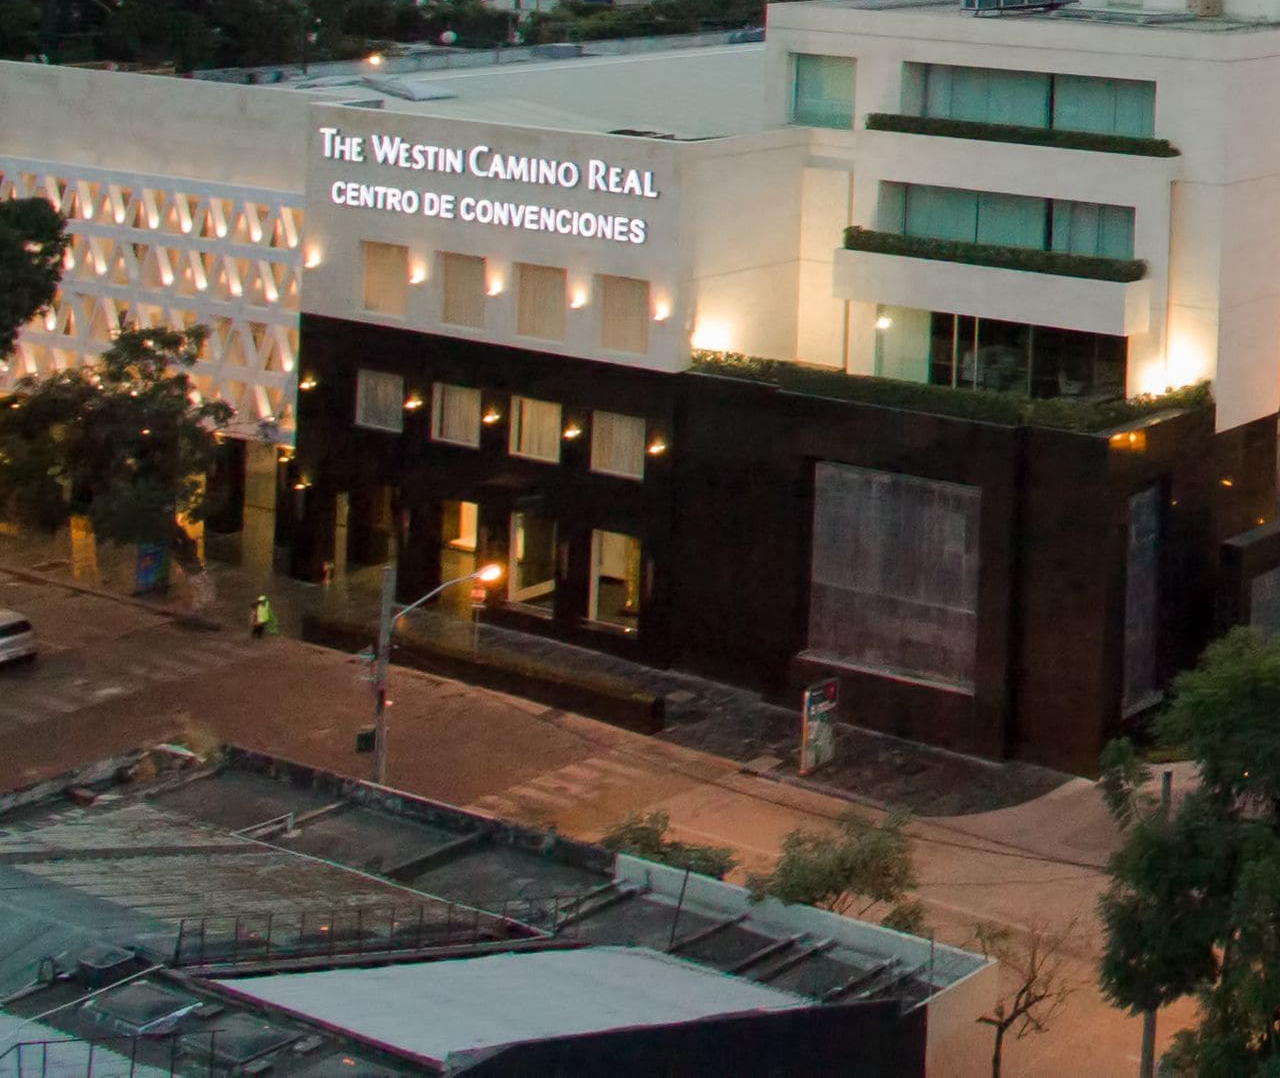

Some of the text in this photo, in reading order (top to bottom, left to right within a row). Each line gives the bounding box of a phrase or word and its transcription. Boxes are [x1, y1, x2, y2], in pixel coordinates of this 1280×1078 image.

[319, 127, 660, 199] THE WESTIN CAMINO REAL
[331, 180, 647, 244] CENTRO DE CONVENCIONES
